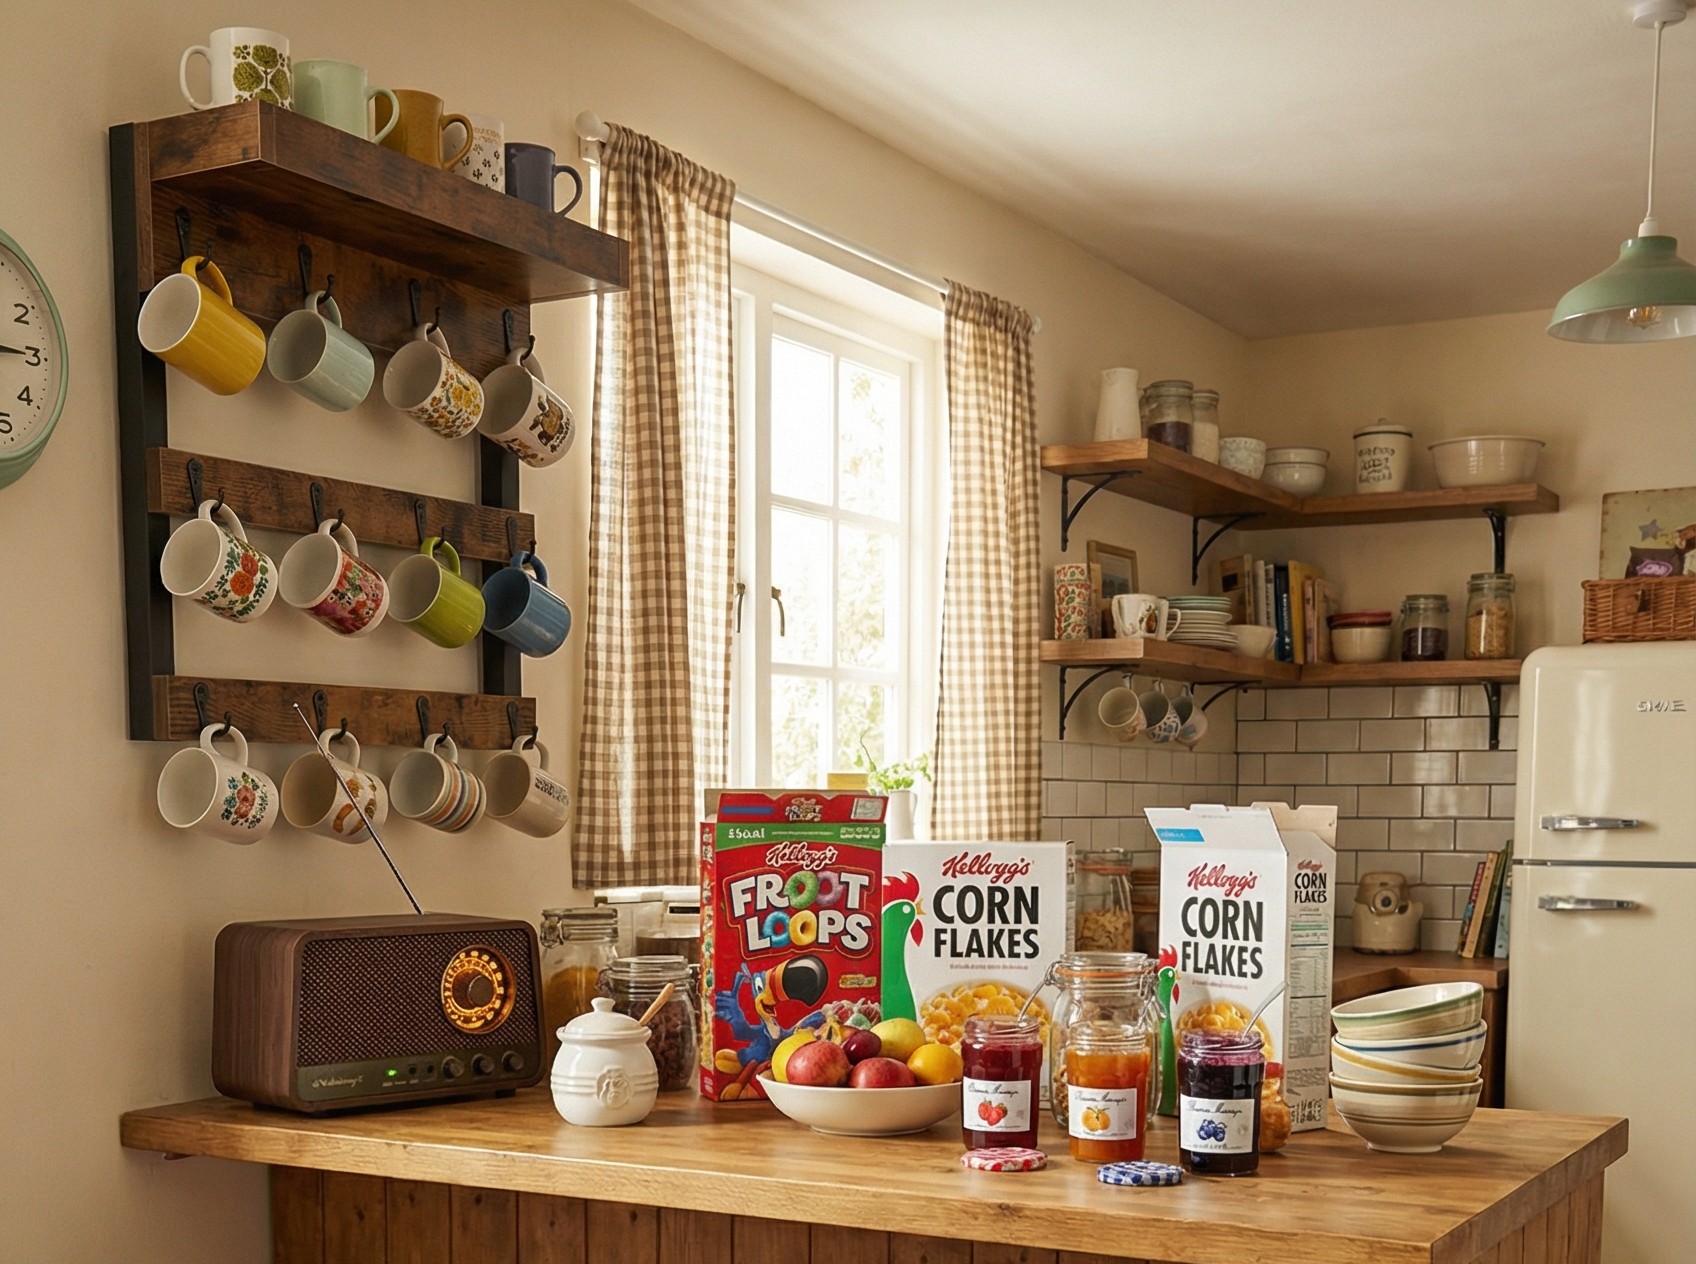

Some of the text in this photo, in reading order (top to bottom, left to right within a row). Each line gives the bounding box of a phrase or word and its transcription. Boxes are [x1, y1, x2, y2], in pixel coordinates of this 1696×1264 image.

[13, 303, 30, 325] 2
[25, 346, 41, 367] 3
[17, 385, 33, 406] 4
[730, 870, 870, 918] FROOT
[1187, 862, 1258, 898] Kellogg's
[1294, 872, 1327, 890] CORN
[933, 885, 1039, 925] CORN
[1181, 896, 1264, 943] CORN
[745, 909, 872, 951] LOOPS
[934, 928, 1040, 959] FLAKES
[1181, 940, 1263, 980] FLAKES
